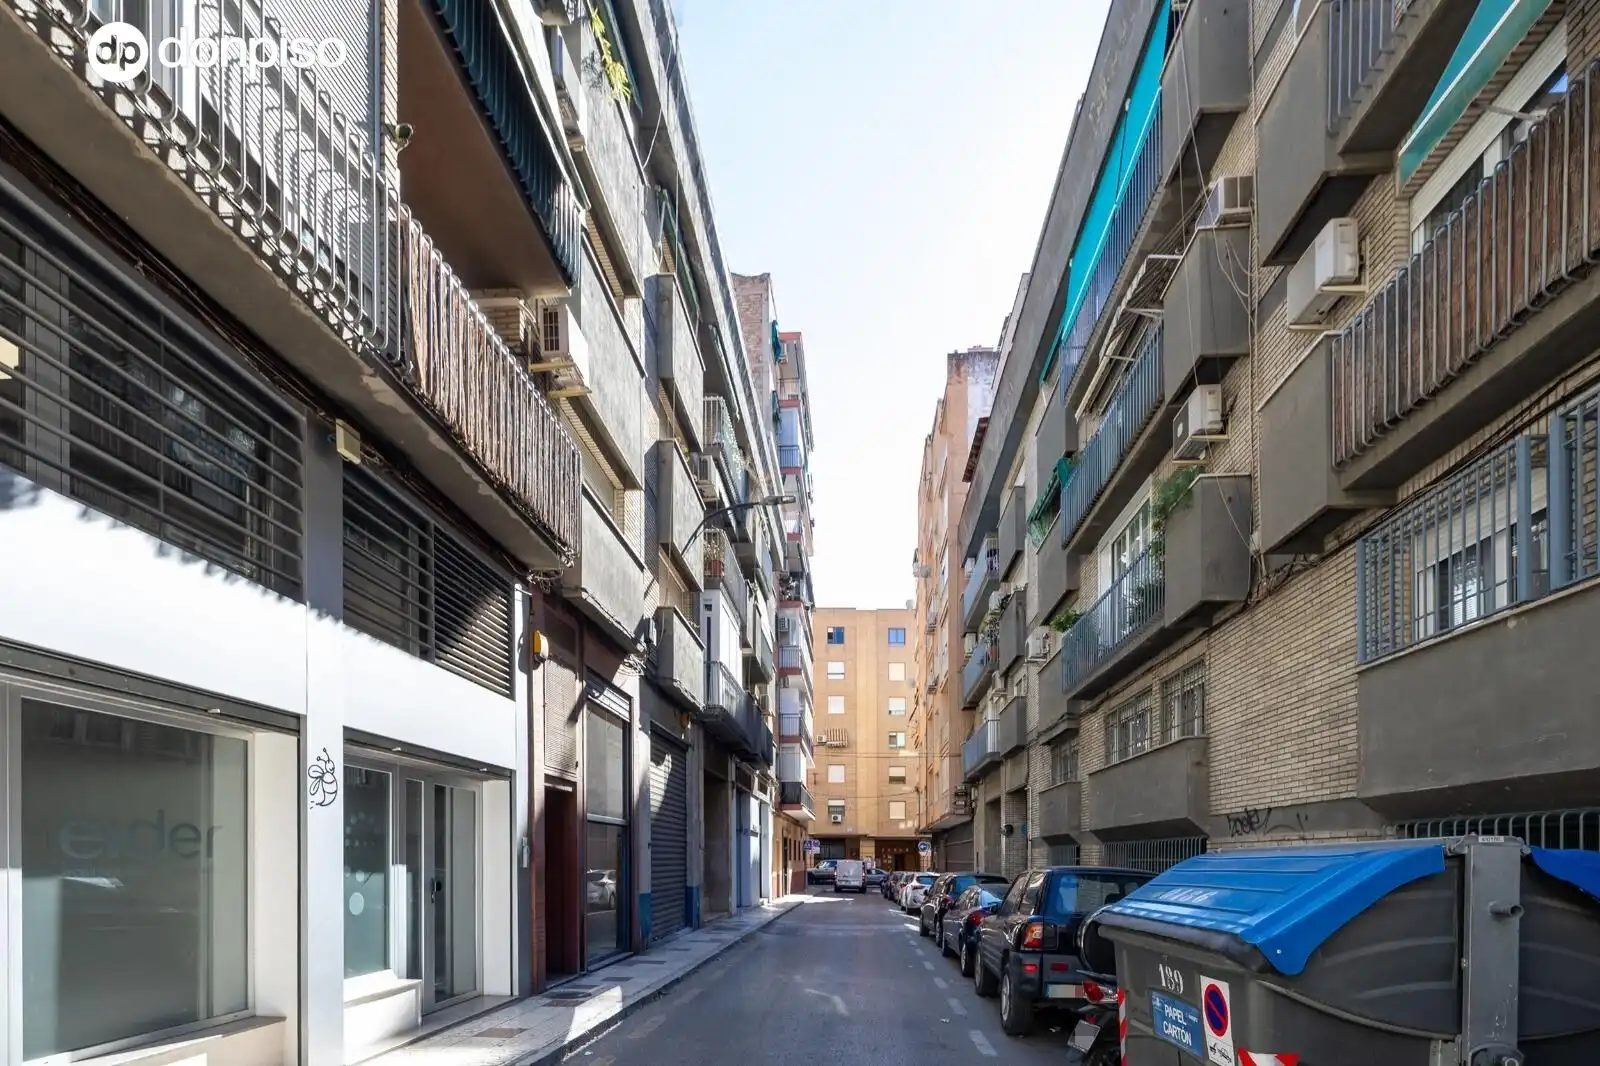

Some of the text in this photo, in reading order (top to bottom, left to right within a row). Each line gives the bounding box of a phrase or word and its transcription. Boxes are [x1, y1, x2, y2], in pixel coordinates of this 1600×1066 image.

[1159, 964, 1184, 994] 189
[1164, 1003, 1187, 1026] PAPEL
[1163, 1020, 1192, 1047] CARTÓN
